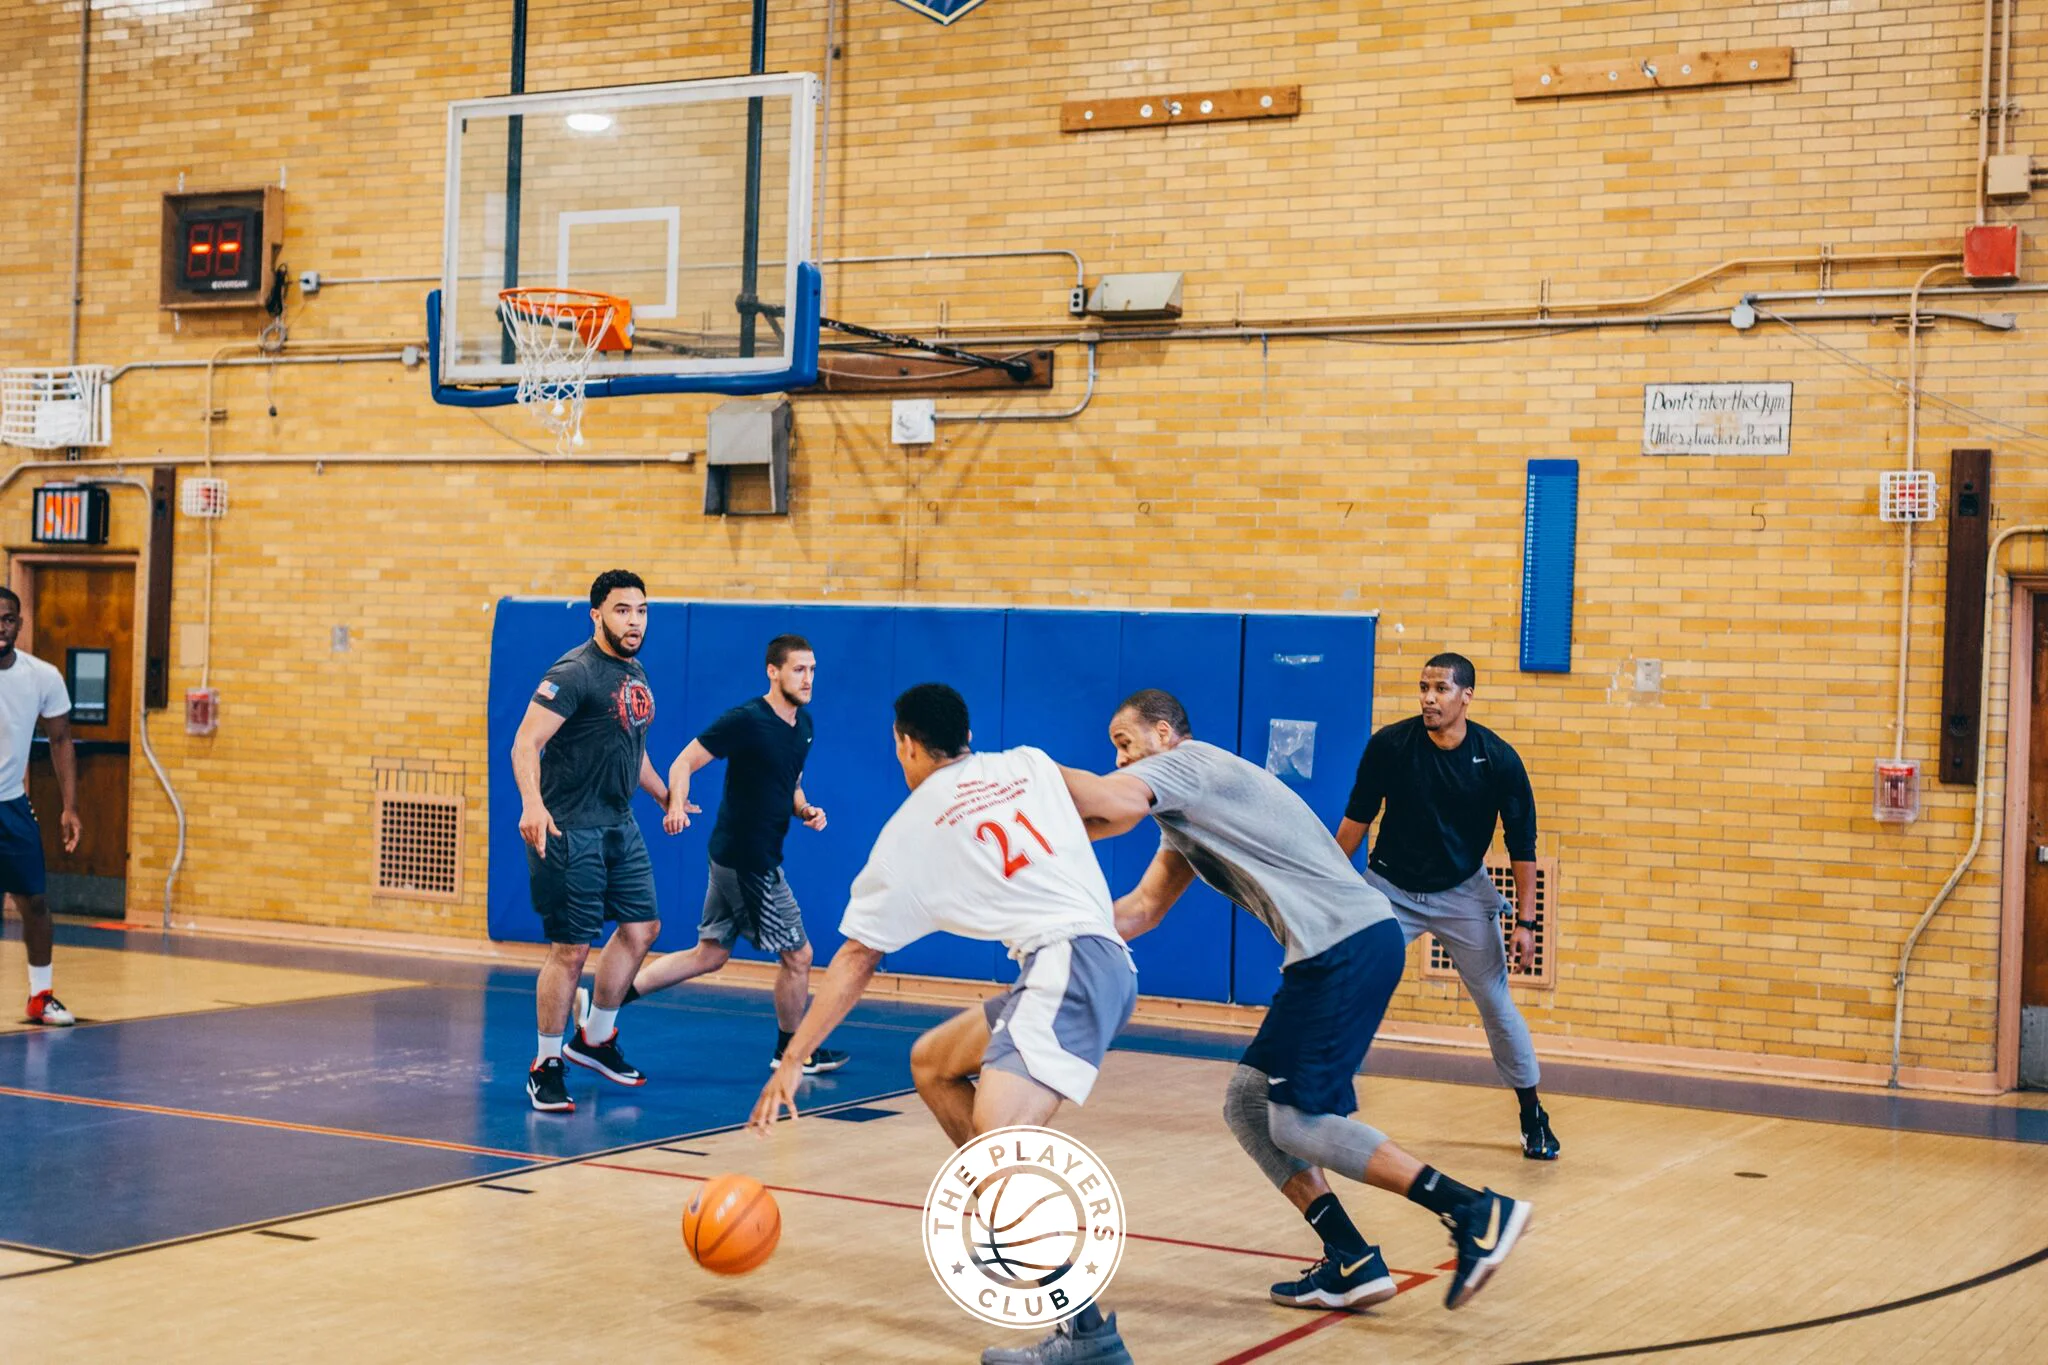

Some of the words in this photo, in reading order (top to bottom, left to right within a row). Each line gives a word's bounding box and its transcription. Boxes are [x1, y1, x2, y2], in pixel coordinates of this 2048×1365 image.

[1689, 390, 1729, 411] Enter
[1731, 390, 1753, 411] the
[1754, 390, 1785, 417] Gym
[1751, 503, 1768, 532] 5
[974, 808, 1056, 881] 21
